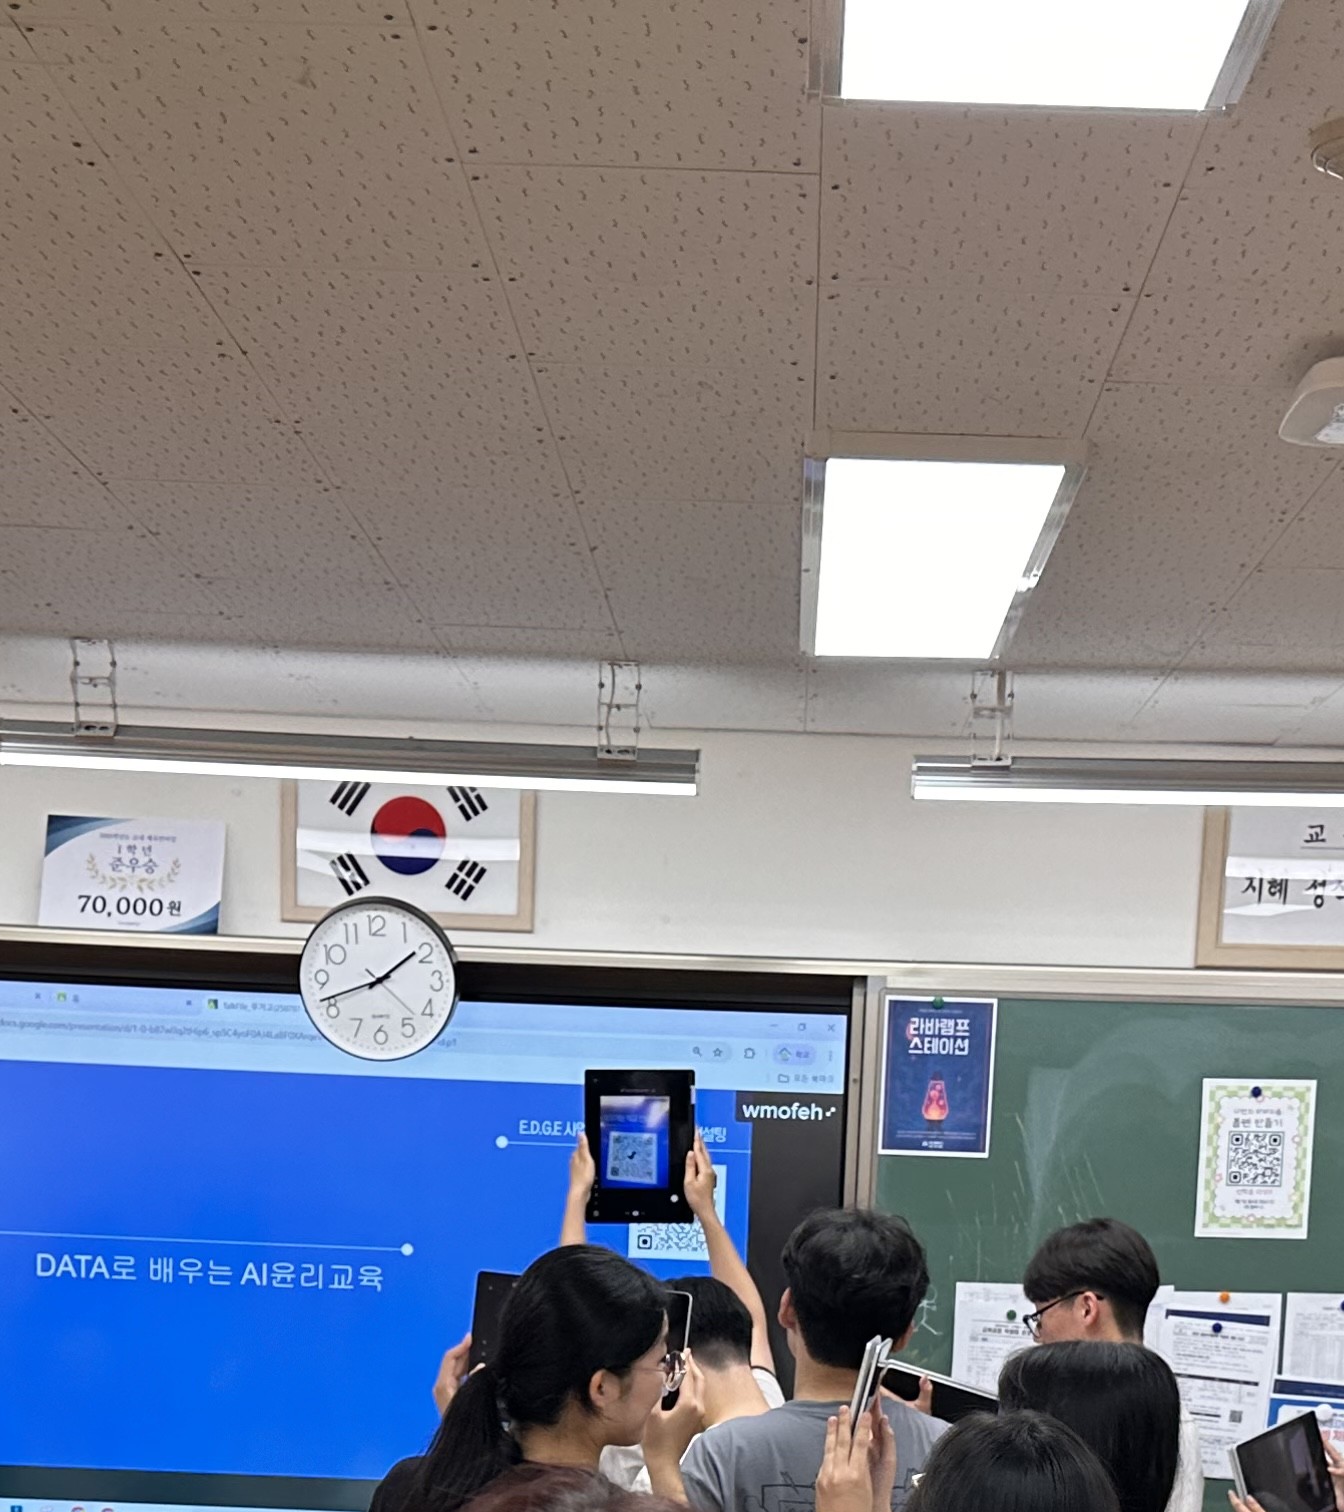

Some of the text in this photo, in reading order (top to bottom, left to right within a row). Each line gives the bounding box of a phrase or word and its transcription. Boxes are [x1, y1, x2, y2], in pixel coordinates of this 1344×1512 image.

[109, 856, 159, 875] 준우승
[77, 895, 182, 918] 70,000원
[343, 922, 359, 945] 11
[367, 914, 386, 937] 12
[401, 921, 407, 944] 1
[323, 944, 347, 965] 10
[418, 942, 434, 964] 2
[314, 968, 330, 990] 9
[429, 969, 444, 992] 3
[326, 996, 340, 1019] 8
[420, 998, 434, 1018] 4
[349, 1018, 363, 1038] 7
[373, 1024, 388, 1045] 6
[400, 1018, 416, 1038] 5
[909, 1017, 970, 1036] 라바램프
[908, 1037, 969, 1056] 스테이션
[742, 1102, 823, 1121] wmofeh
[35, 1252, 383, 1292] DATA로 배우는 AI윤리교육
